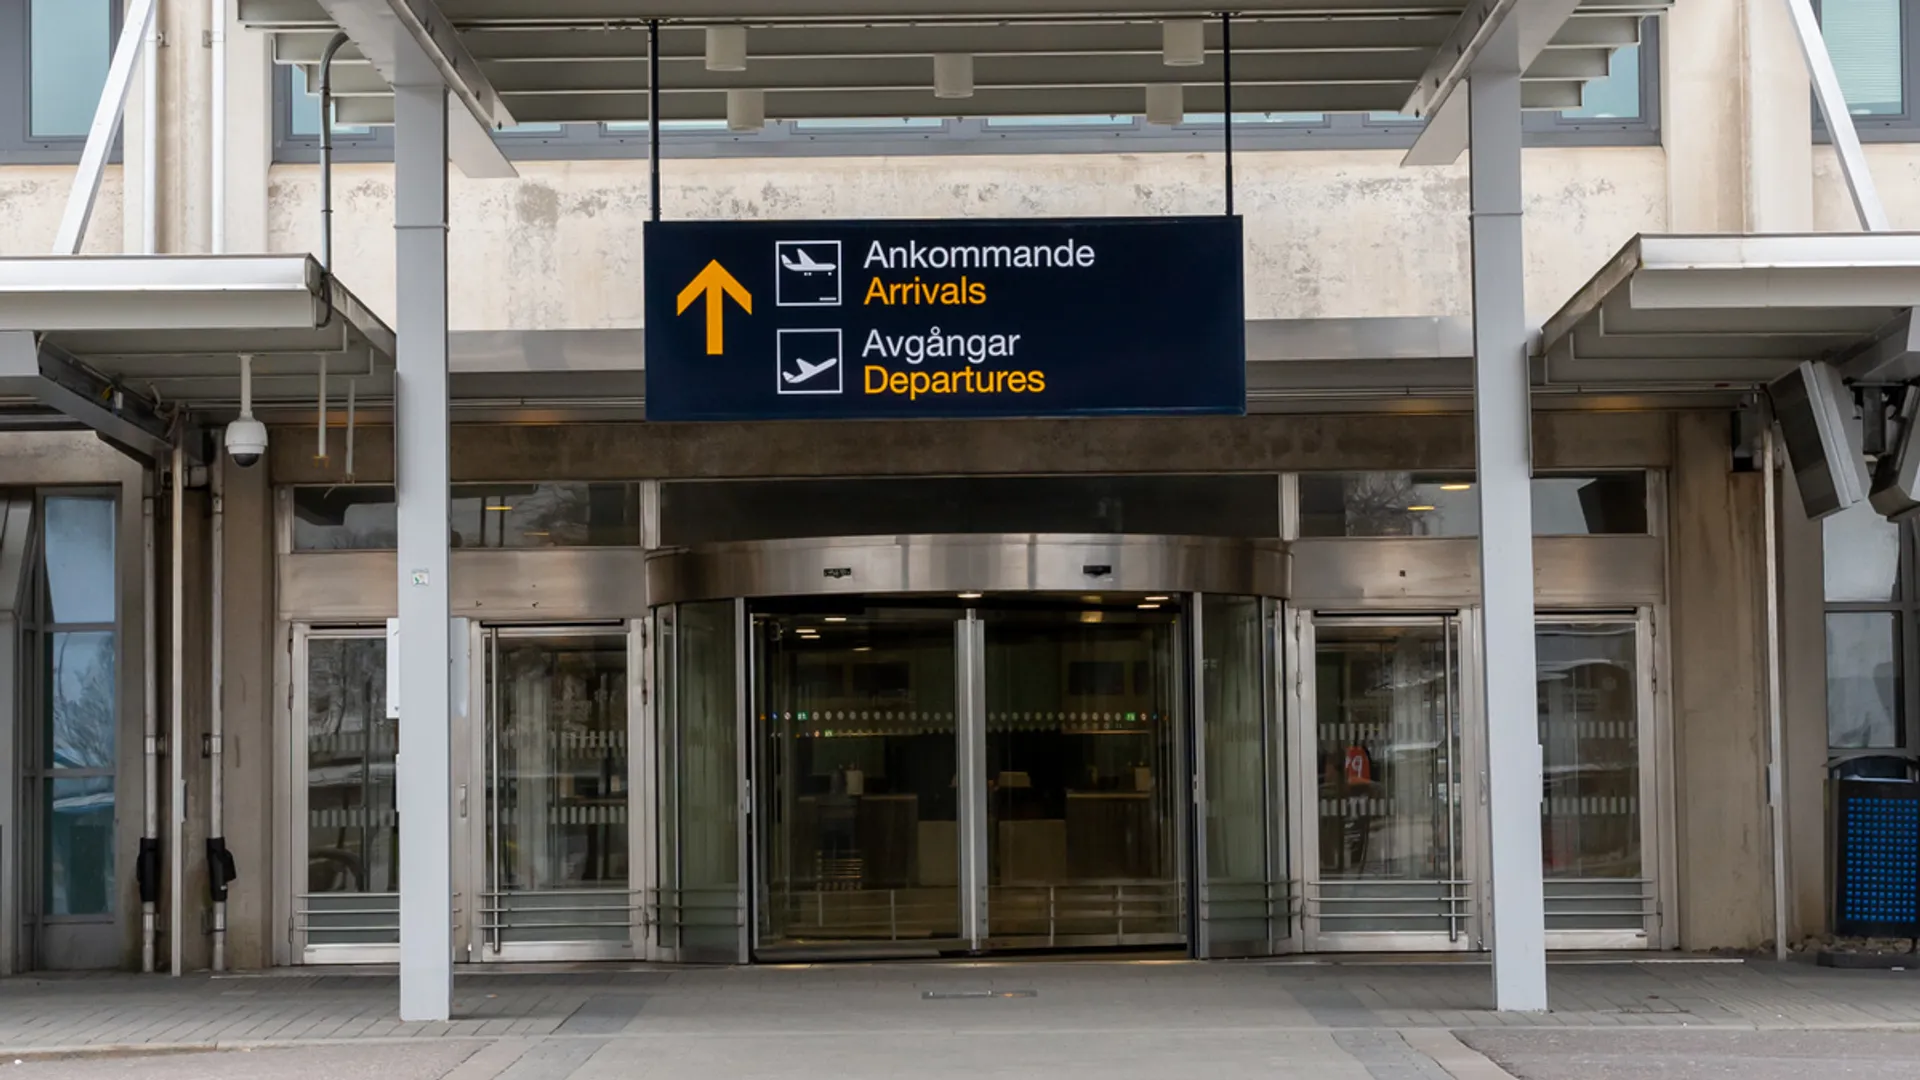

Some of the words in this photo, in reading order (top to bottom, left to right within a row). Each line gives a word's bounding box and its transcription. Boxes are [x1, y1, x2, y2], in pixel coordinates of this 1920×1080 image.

[864, 239, 1095, 269] Ankommande
[864, 276, 986, 306] Arrivals
[862, 326, 1021, 364] Avgångar
[864, 364, 1046, 401] Departures
